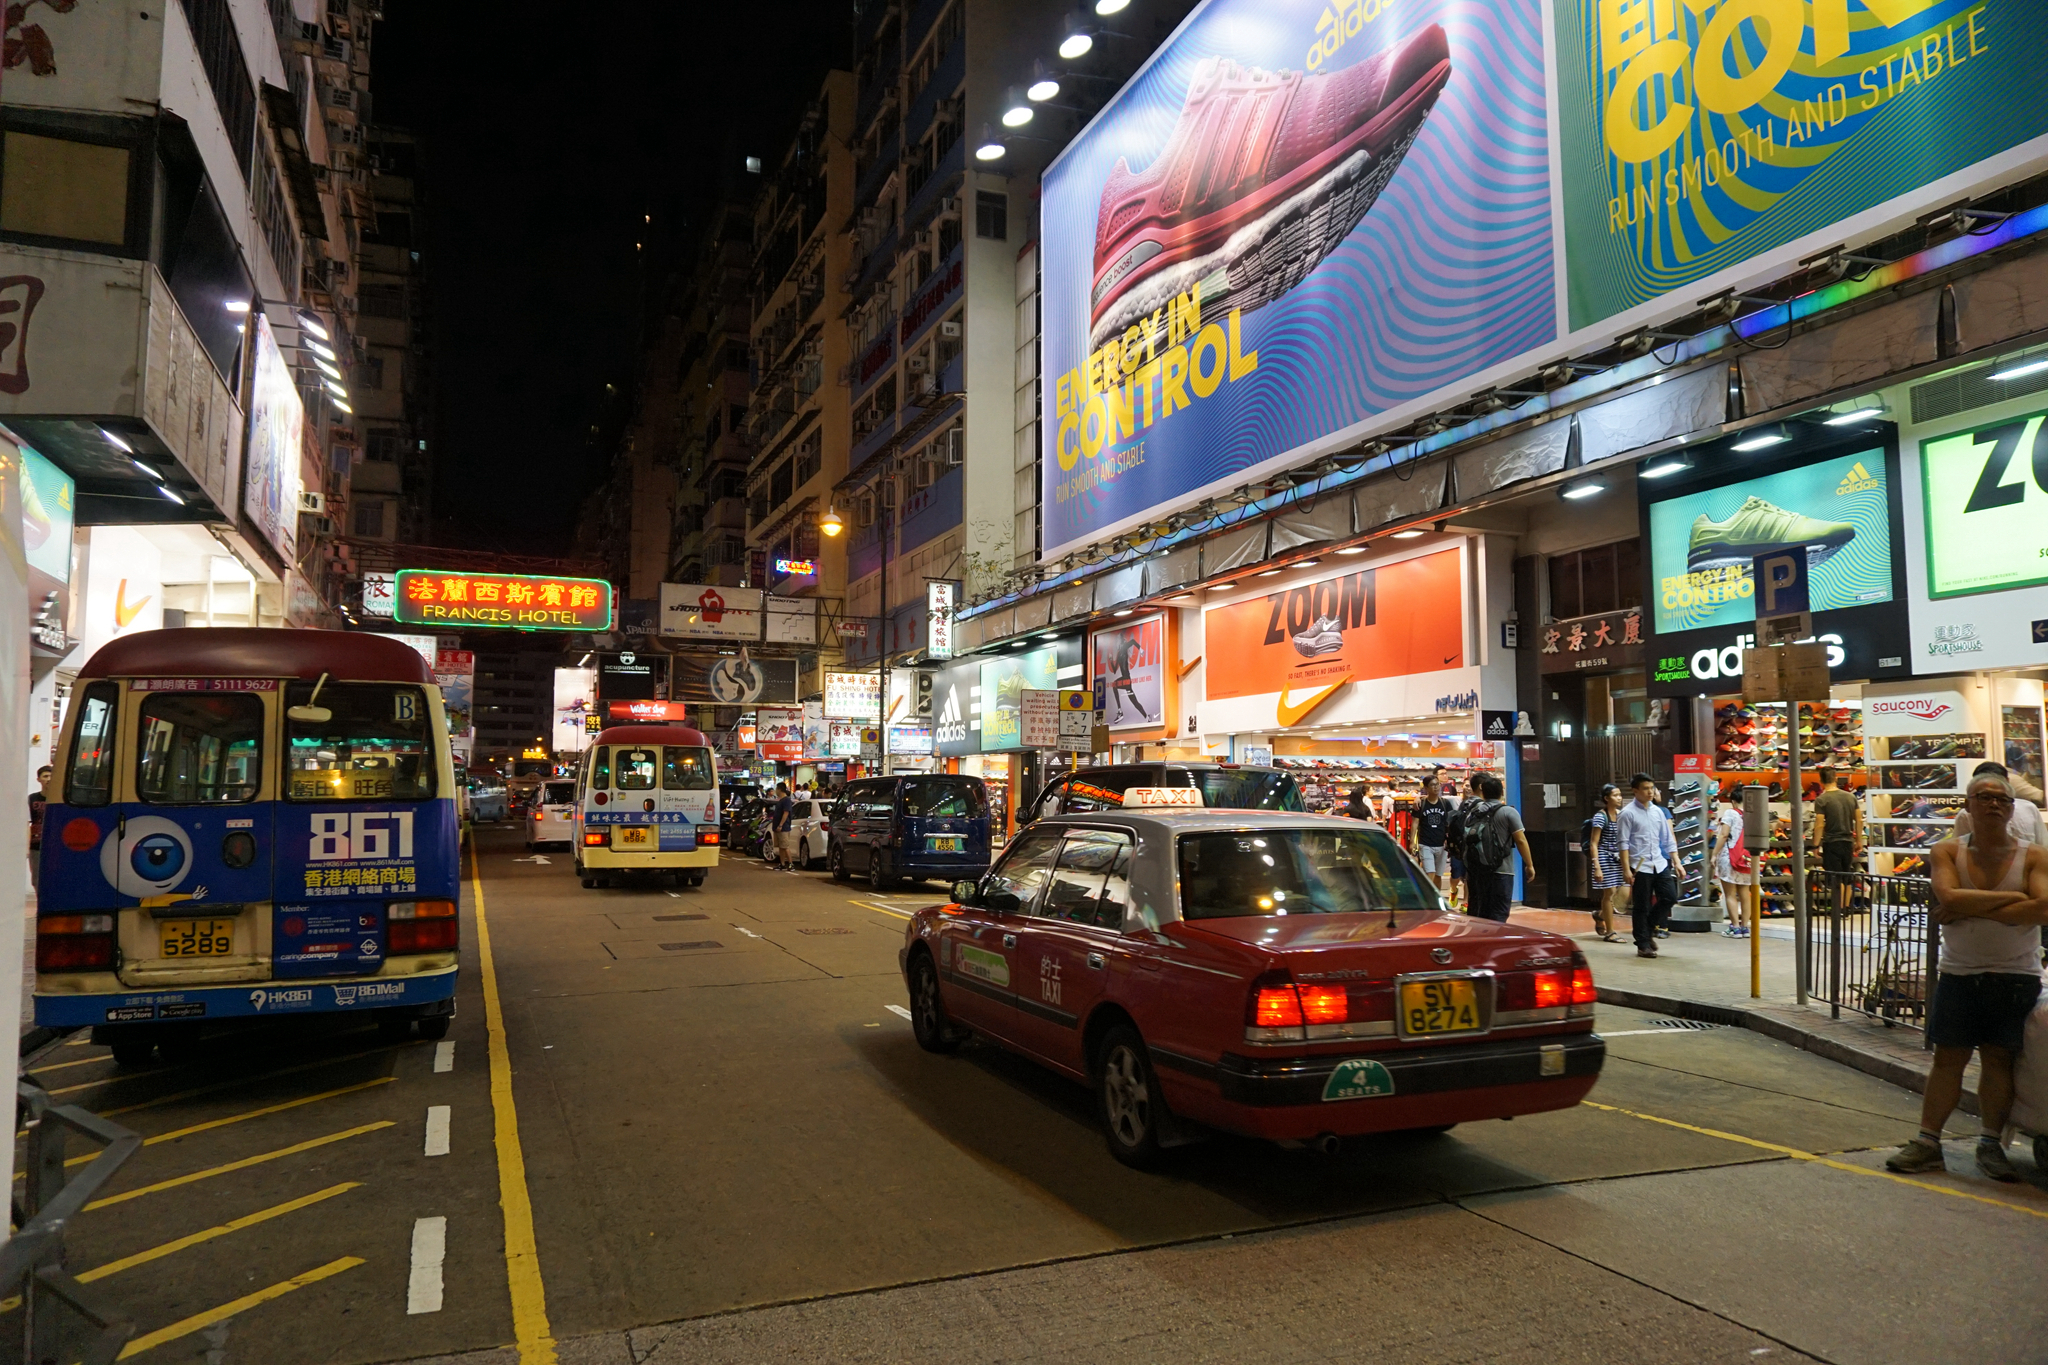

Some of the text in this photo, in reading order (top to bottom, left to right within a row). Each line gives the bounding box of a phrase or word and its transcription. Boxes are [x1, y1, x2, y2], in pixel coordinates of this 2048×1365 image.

[1306, 0, 1393, 70] adida
[1609, 6, 1989, 234] RUN SMOOTH AND STABLE
[1113, 254, 1134, 279] boost
[1056, 280, 1201, 419] ENERGY IN
[1056, 306, 1259, 472] CONTROL
[1056, 440, 1146, 504] RUN SMOOTH AND STABLE
[1836, 479, 1879, 496] adidas
[1662, 564, 1743, 592] ENERGY IN
[1763, 555, 1797, 611] P
[407, 577, 598, 608] 法蘭西斯賓館
[1662, 577, 1755, 610] CONTRO
[423, 604, 582, 625] FRANCIS HOTEL
[1263, 569, 1377, 646] ZOOM
[625, 624, 658, 635] SPALDI
[1541, 611, 1646, 655] 宏景大廈
[1935, 623, 1979, 642] 運動家
[1690, 633, 1846, 681] ads
[1879, 659, 1890, 668] 61
[604, 664, 651, 672] acupuncture
[1294, 672, 1304, 680] FAST,
[1304, 669, 1320, 677] THERE'S
[1327, 665, 1346, 674] SHAKING
[214, 679, 274, 690] 5111 9627
[1095, 681, 1104, 708] P
[397, 695, 414, 720] B
[1872, 698, 1934, 713] saucony
[1081, 712, 1087, 721] 7
[936, 721, 966, 744] adidas
[983, 719, 1017, 737] CONTROL
[1081, 725, 1087, 733] 7
[1486, 728, 1509, 736] adidas
[1925, 737, 1982, 747] TRMPH
[749, 766, 762, 774] $78
[353, 778, 393, 797] 旺角
[1136, 789, 1196, 805] TAXI
[590, 813, 681, 823] 鮮味之最 越香魚露
[309, 811, 414, 860] 861
[305, 859, 415, 868] www.HK861.com www.861Mall.com
[303, 866, 416, 888] 香港網絡商場
[181, 921, 214, 938] JJ
[164, 936, 230, 956] 5289
[280, 951, 339, 961] caringcompany
[1040, 955, 1062, 981] 的士
[268, 989, 313, 1004] HK861
[358, 982, 405, 997] 861Mall
[1040, 977, 1061, 1006] TAXI
[1423, 984, 1453, 1008] SV
[118, 1011, 152, 1021] App Store
[168, 1007, 204, 1017] Google play
[1410, 1006, 1474, 1032] 8274
[1345, 1061, 1375, 1071] TAXI
[1352, 1070, 1367, 1086] 4
[1337, 1084, 1380, 1098] SEATS
